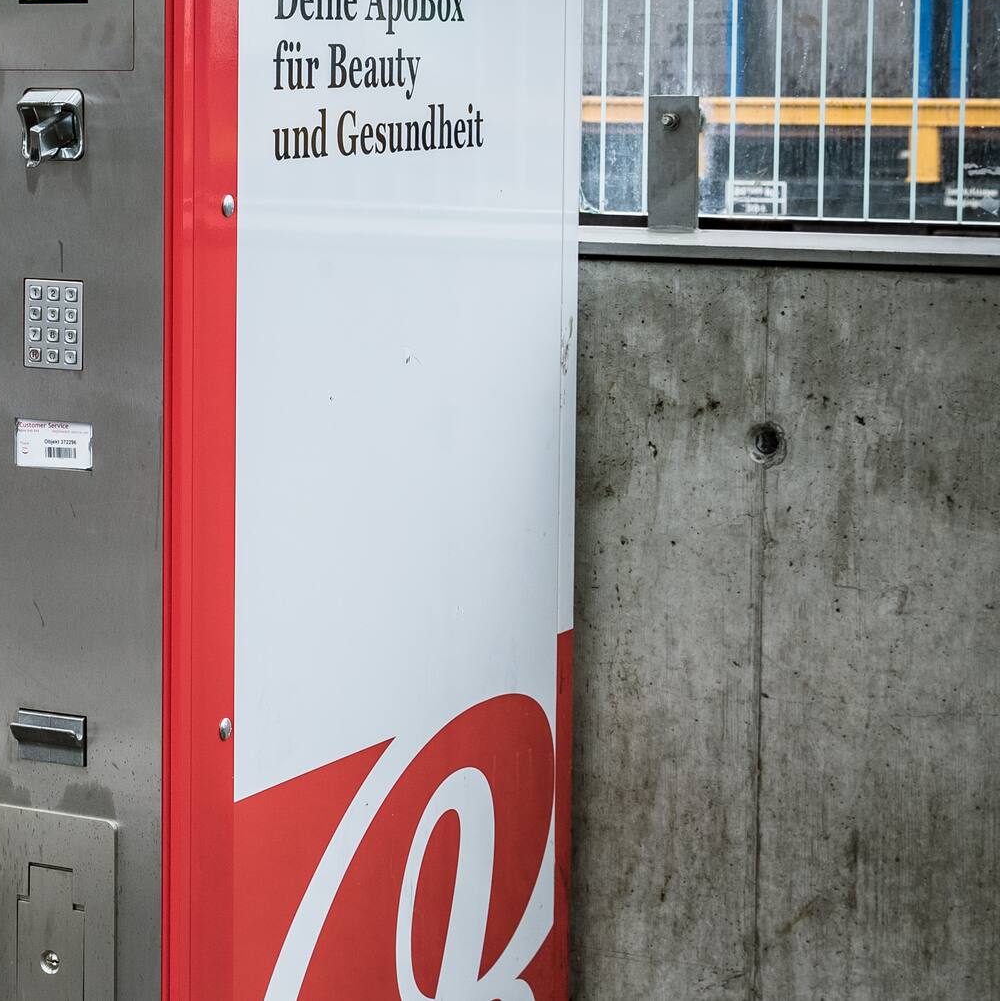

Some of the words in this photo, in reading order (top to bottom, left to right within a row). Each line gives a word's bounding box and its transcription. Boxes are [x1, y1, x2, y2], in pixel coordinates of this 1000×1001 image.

[272, 39, 320, 91] für
[327, 42, 421, 101] Beauty
[272, 108, 329, 161] und
[336, 102, 484, 157] Gesundheit
[50, 289, 56, 298] 2
[69, 289, 74, 298] 3
[50, 310, 56, 318] 5
[50, 331, 56, 339] 8
[68, 332, 74, 340] 9
[18, 421, 46, 429] Customer
[44, 438, 60, 446] Objekt
